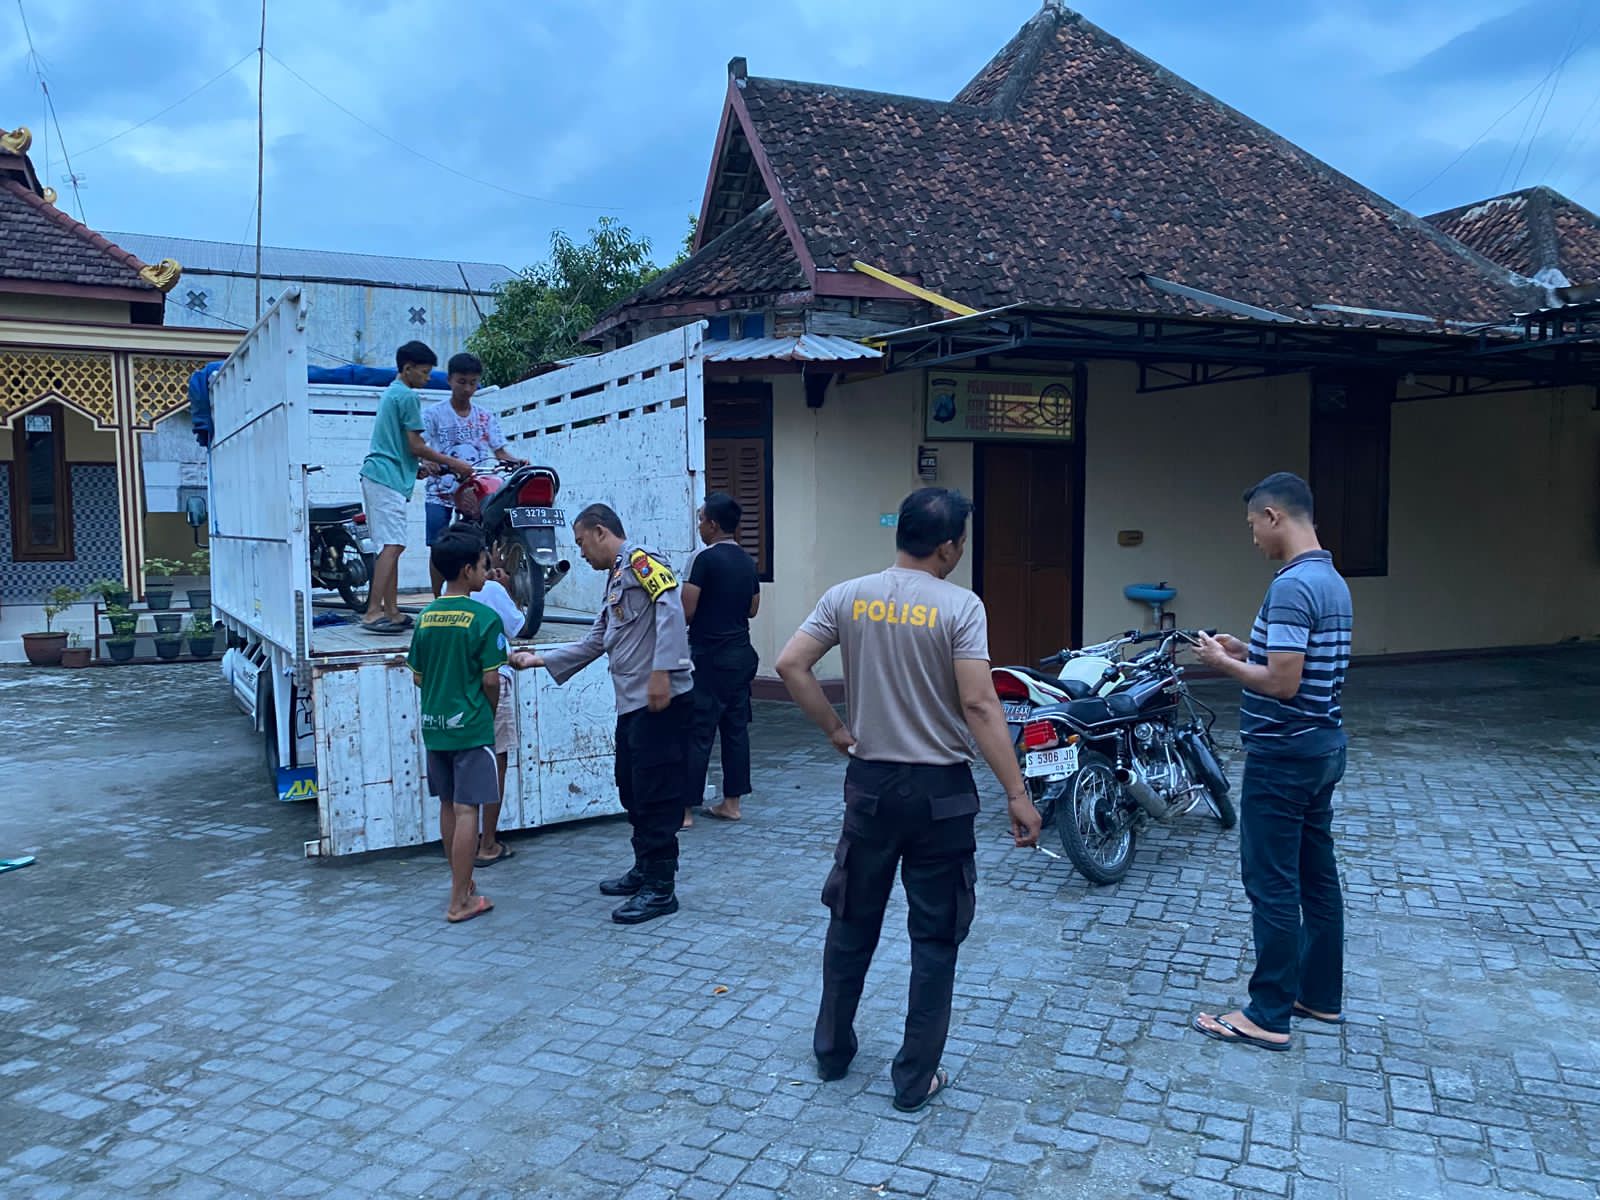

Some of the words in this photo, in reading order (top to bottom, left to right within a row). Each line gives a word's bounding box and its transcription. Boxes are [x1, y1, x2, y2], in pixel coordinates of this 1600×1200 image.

[511, 510, 518, 518] S
[525, 509, 546, 517] 3279
[852, 599, 939, 629] POLISI
[1028, 755, 1034, 766] S
[1037, 751, 1059, 765] 5306
[1064, 749, 1075, 761] JD
